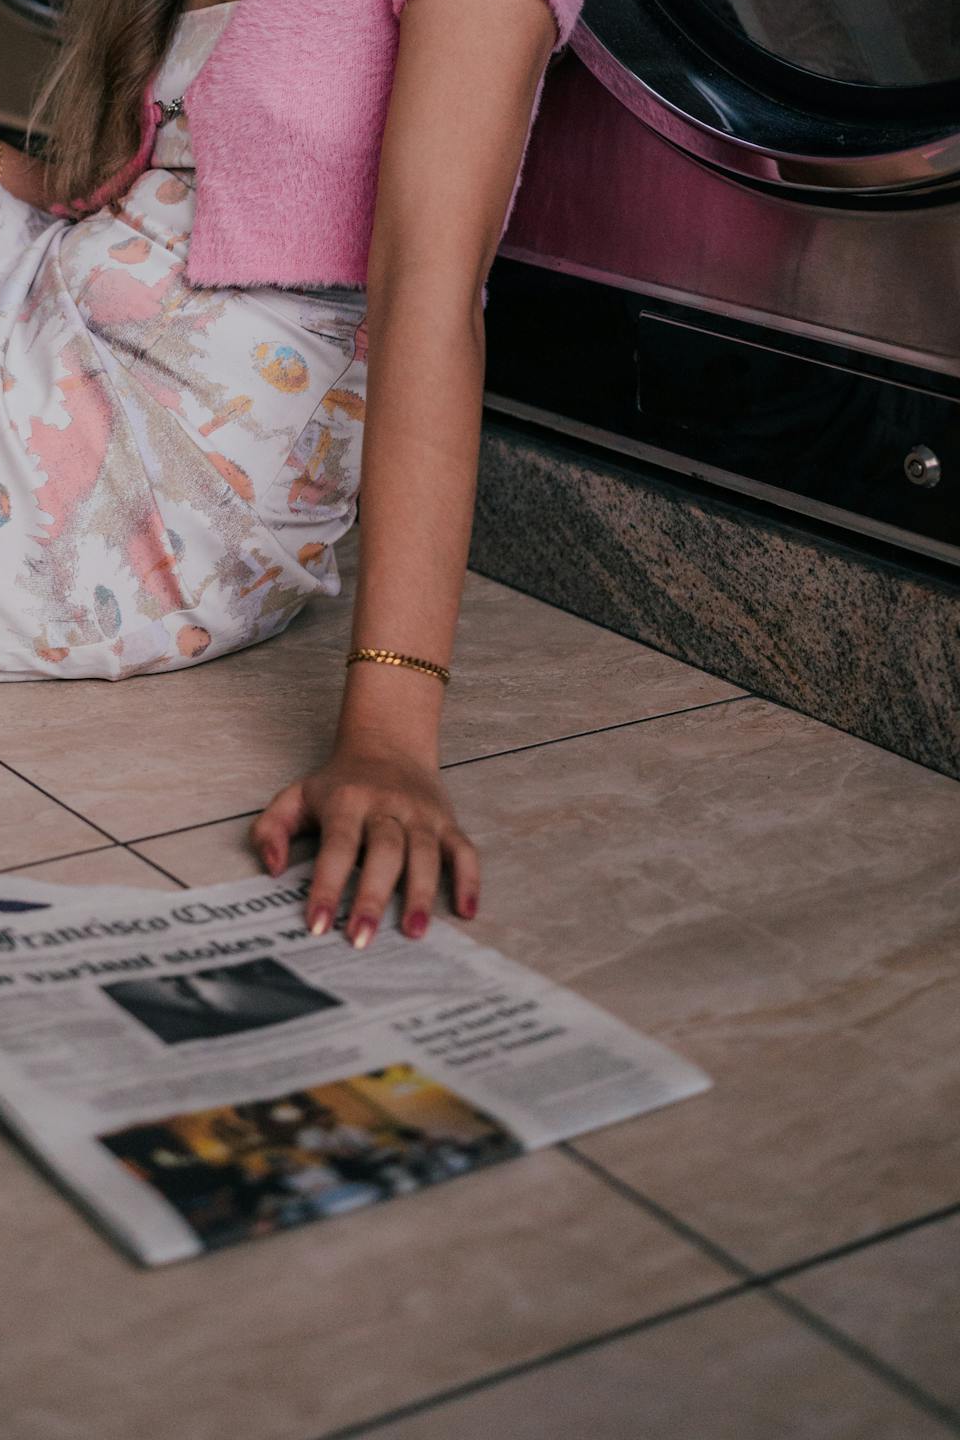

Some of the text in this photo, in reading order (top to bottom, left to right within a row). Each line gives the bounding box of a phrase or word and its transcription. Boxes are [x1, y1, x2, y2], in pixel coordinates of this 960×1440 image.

[171, 877, 312, 923] Chronic
[24, 953, 153, 985] variant
[161, 933, 276, 966] stokes
